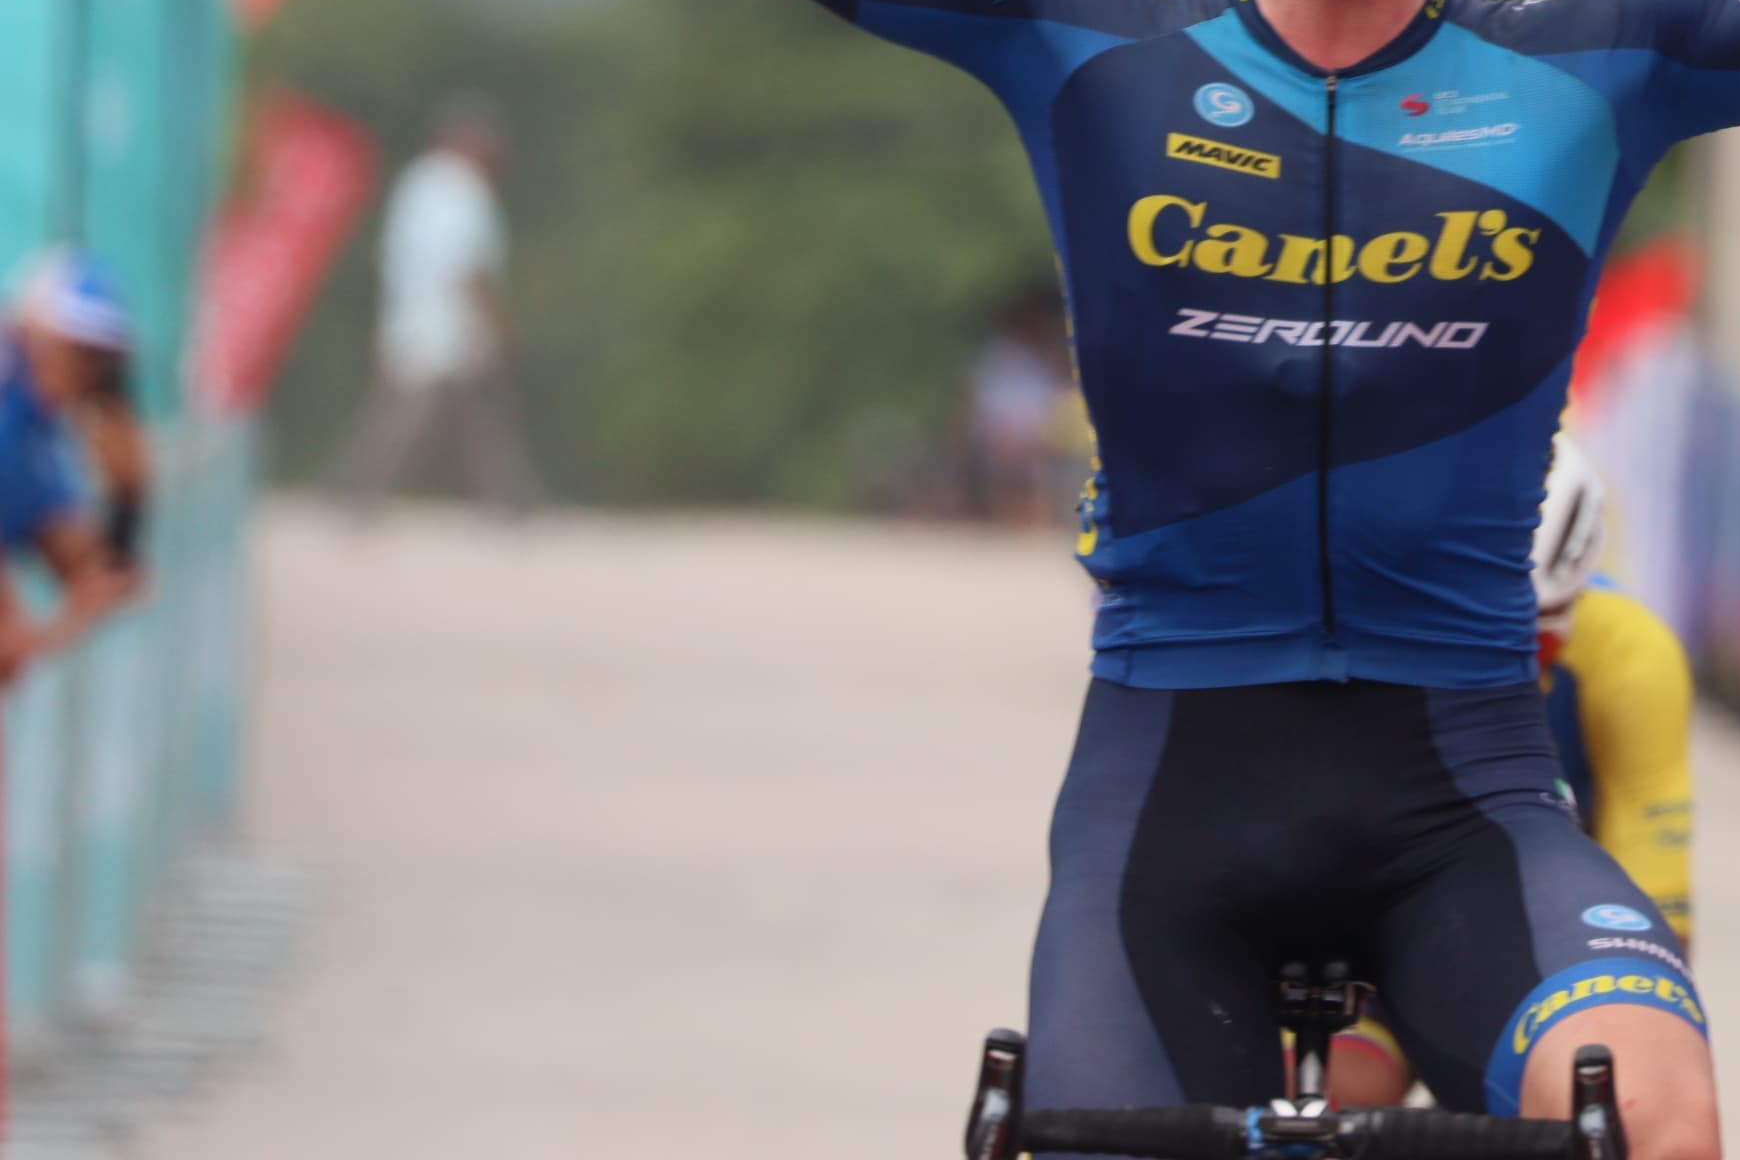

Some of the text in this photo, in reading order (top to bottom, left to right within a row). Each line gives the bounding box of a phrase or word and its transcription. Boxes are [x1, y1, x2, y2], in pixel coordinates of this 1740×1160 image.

[1174, 140, 1273, 172] MAVIC
[1127, 194, 1541, 285] Canel's
[1168, 308, 1490, 349] ZEROUNO
[1513, 974, 1704, 1055] Canel's
